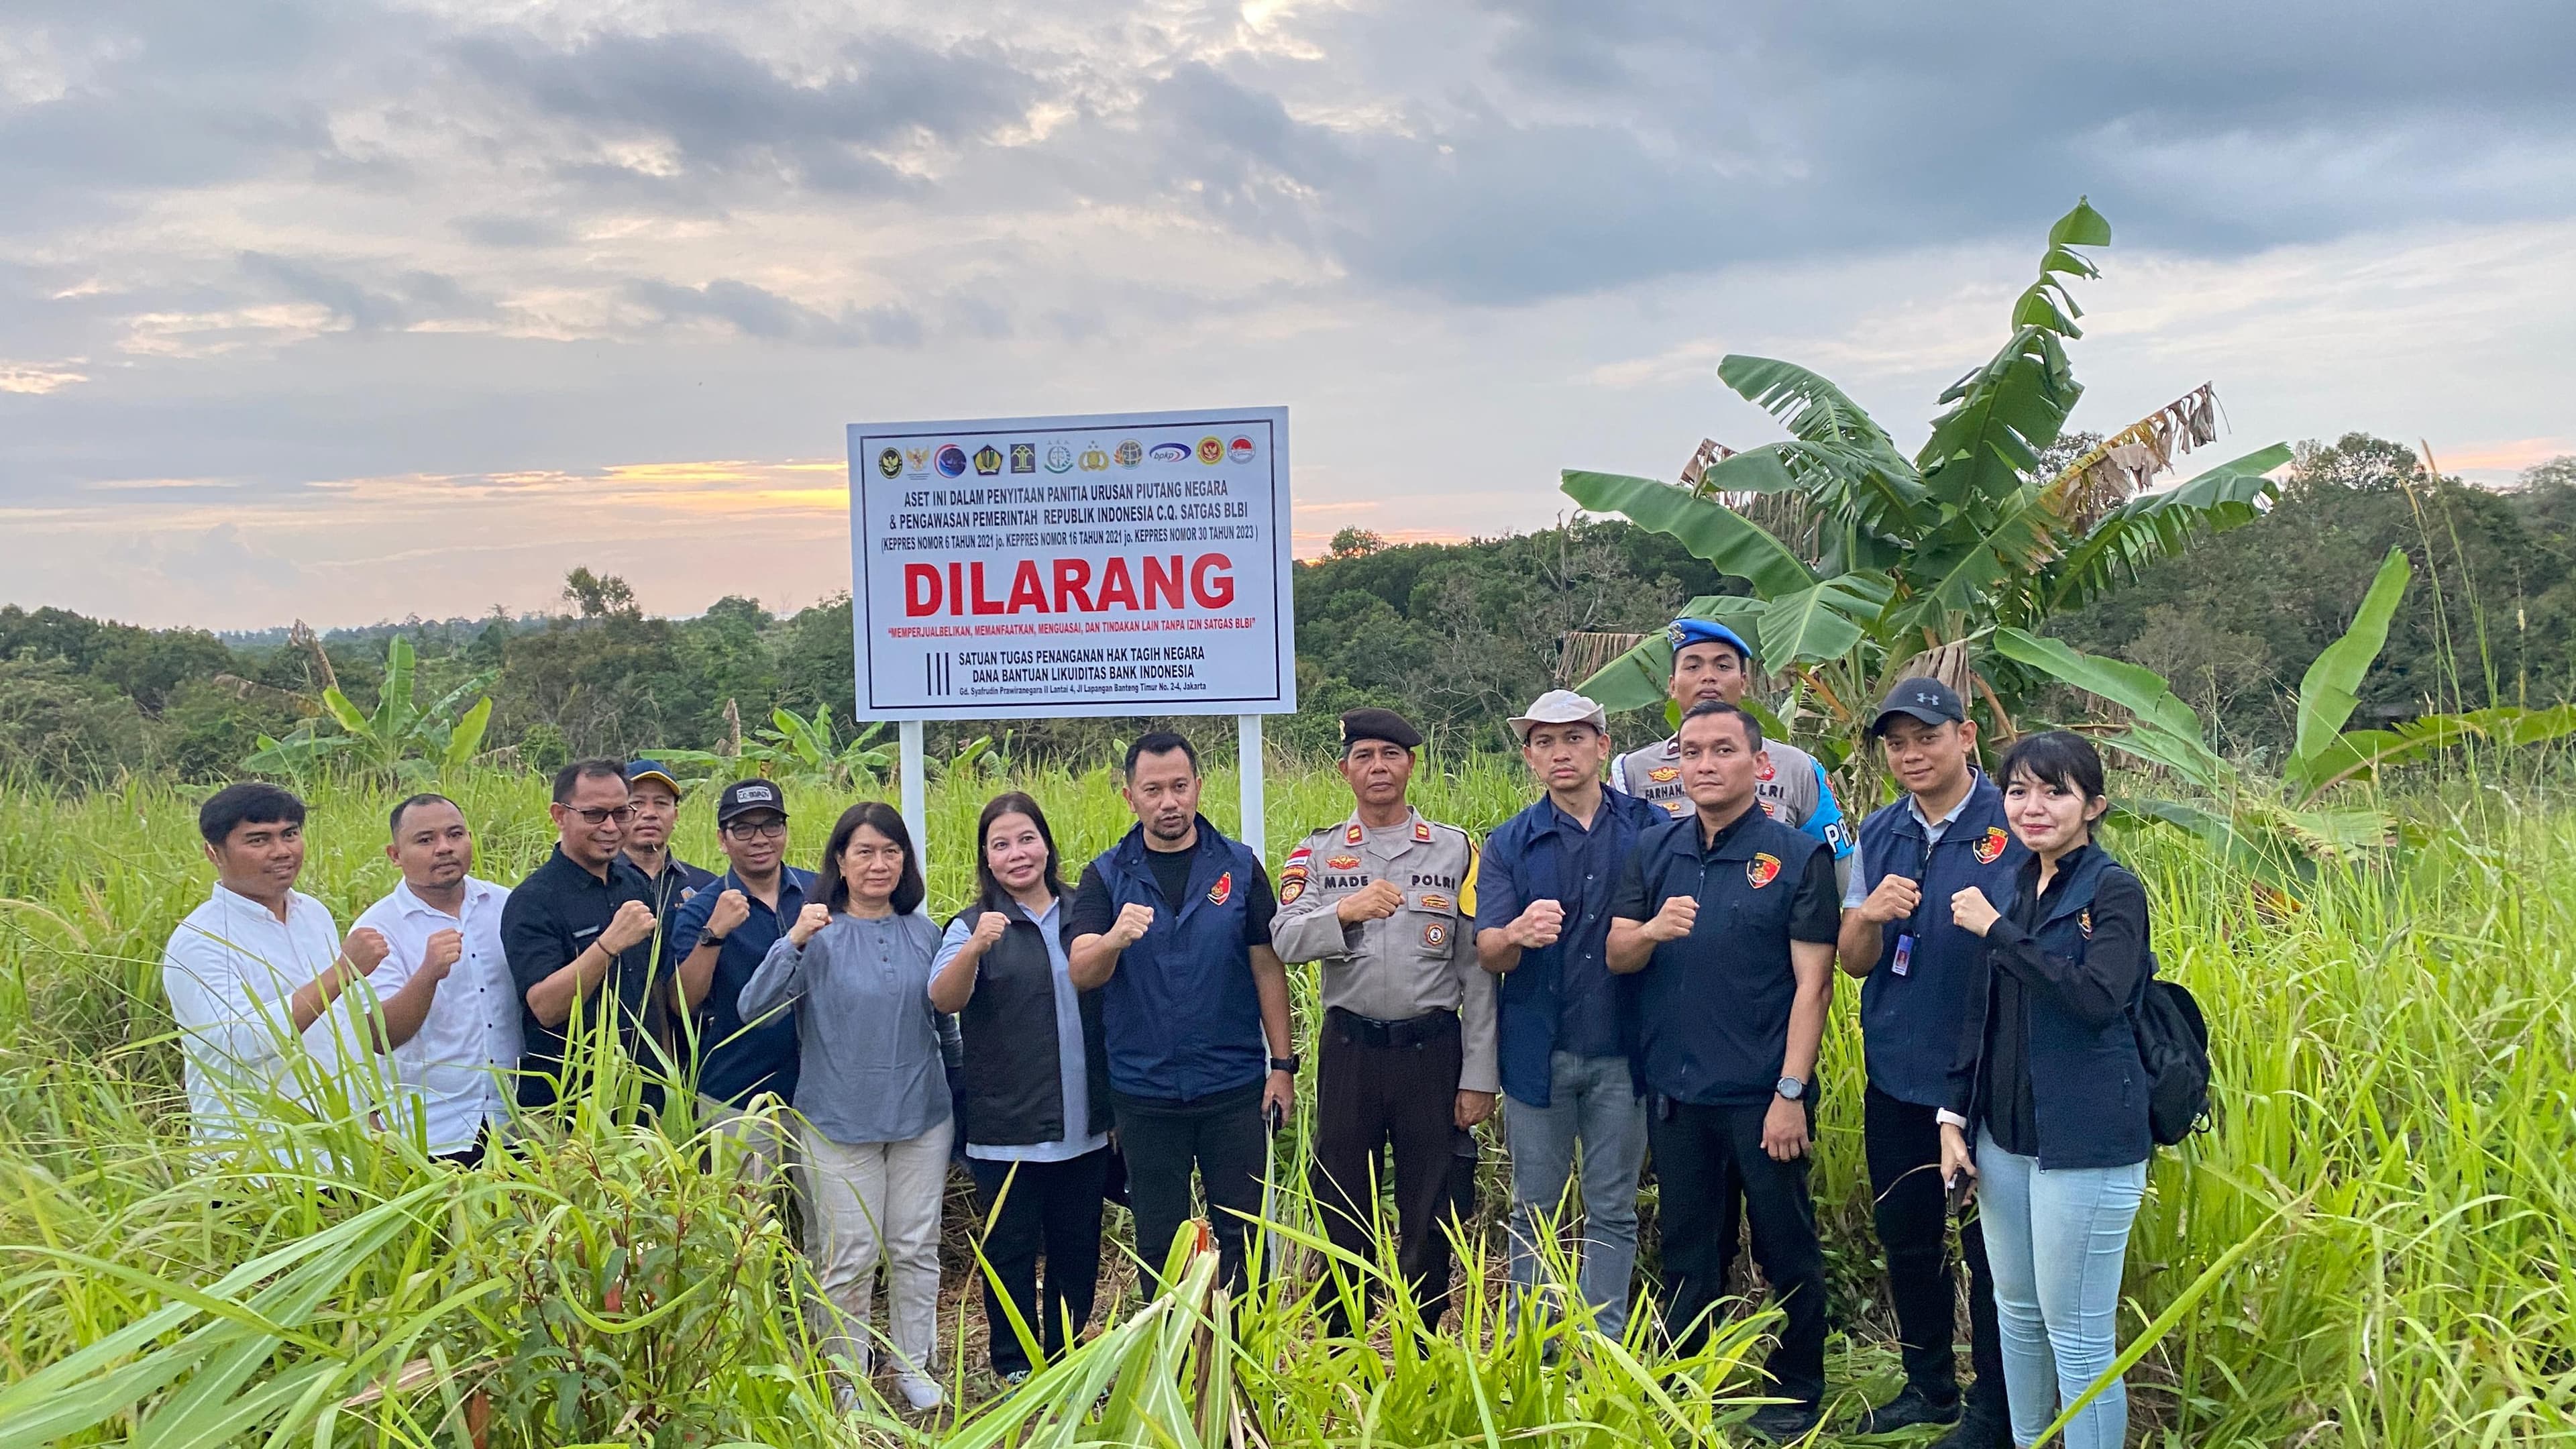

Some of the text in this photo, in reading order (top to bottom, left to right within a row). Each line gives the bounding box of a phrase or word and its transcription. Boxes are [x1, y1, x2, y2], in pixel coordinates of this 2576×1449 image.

[1153, 451, 1175, 461] bpkp
[904, 480, 1228, 507] ASET INI DALAM PENYITAAN PANITIA URUSAN PIUTANG NEGARA
[890, 501, 1247, 529] & PENGAWASAN PEMERINTAH REPUBLIK INDONESIA C.Q. SATGAS BLBI
[917, 536, 943, 549] NOMOR
[945, 535, 949, 549] 6
[951, 535, 975, 549] TAHUN
[977, 534, 993, 547] 2021
[996, 534, 1004, 551] jo.
[1006, 532, 1038, 547] KEPPRES
[1040, 532, 1067, 545] NOMOR
[1069, 531, 1077, 545] 16
[1079, 530, 1104, 544] TAHUN
[1106, 529, 1122, 543] 2021
[1124, 529, 1132, 546] jo.
[1134, 528, 1167, 542] KEPPRES
[1170, 527, 1196, 541] NOMOR
[1198, 527, 1207, 540] 30
[1209, 525, 1234, 539] TAHUN
[1236, 525, 1253, 539] 2023
[905, 553, 1234, 616] DILARANG
[975, 624, 1036, 636] MEMANFAATKAN,
[1038, 622, 1083, 635] MENGUASAI,
[1085, 622, 1099, 633] DAN
[1102, 621, 1139, 632] TINDAKAN
[1142, 620, 1159, 631] LAIN
[1161, 619, 1185, 631] TANPA
[1187, 619, 1201, 630] IZIN
[1204, 618, 1233, 629] SATGAS
[959, 645, 1204, 665] SATUAN TUGAS PENANGANAN HAK TAGIH NEGARA
[973, 664, 1194, 682] DANA BANTUAN LIKUIDITAS BANK INDONESIA
[971, 687, 998, 697] Syafrudin
[1000, 686, 1042, 695] Prawiranegara
[1050, 685, 1068, 693] Lantai
[1083, 684, 1112, 694] Lapangan
[1114, 684, 1138, 693] Banteng
[1140, 683, 1157, 691] Timur
[1183, 682, 1206, 690] Jakarta
[1324, 875, 1368, 889] MADE
[1411, 875, 1455, 890] POLRI
